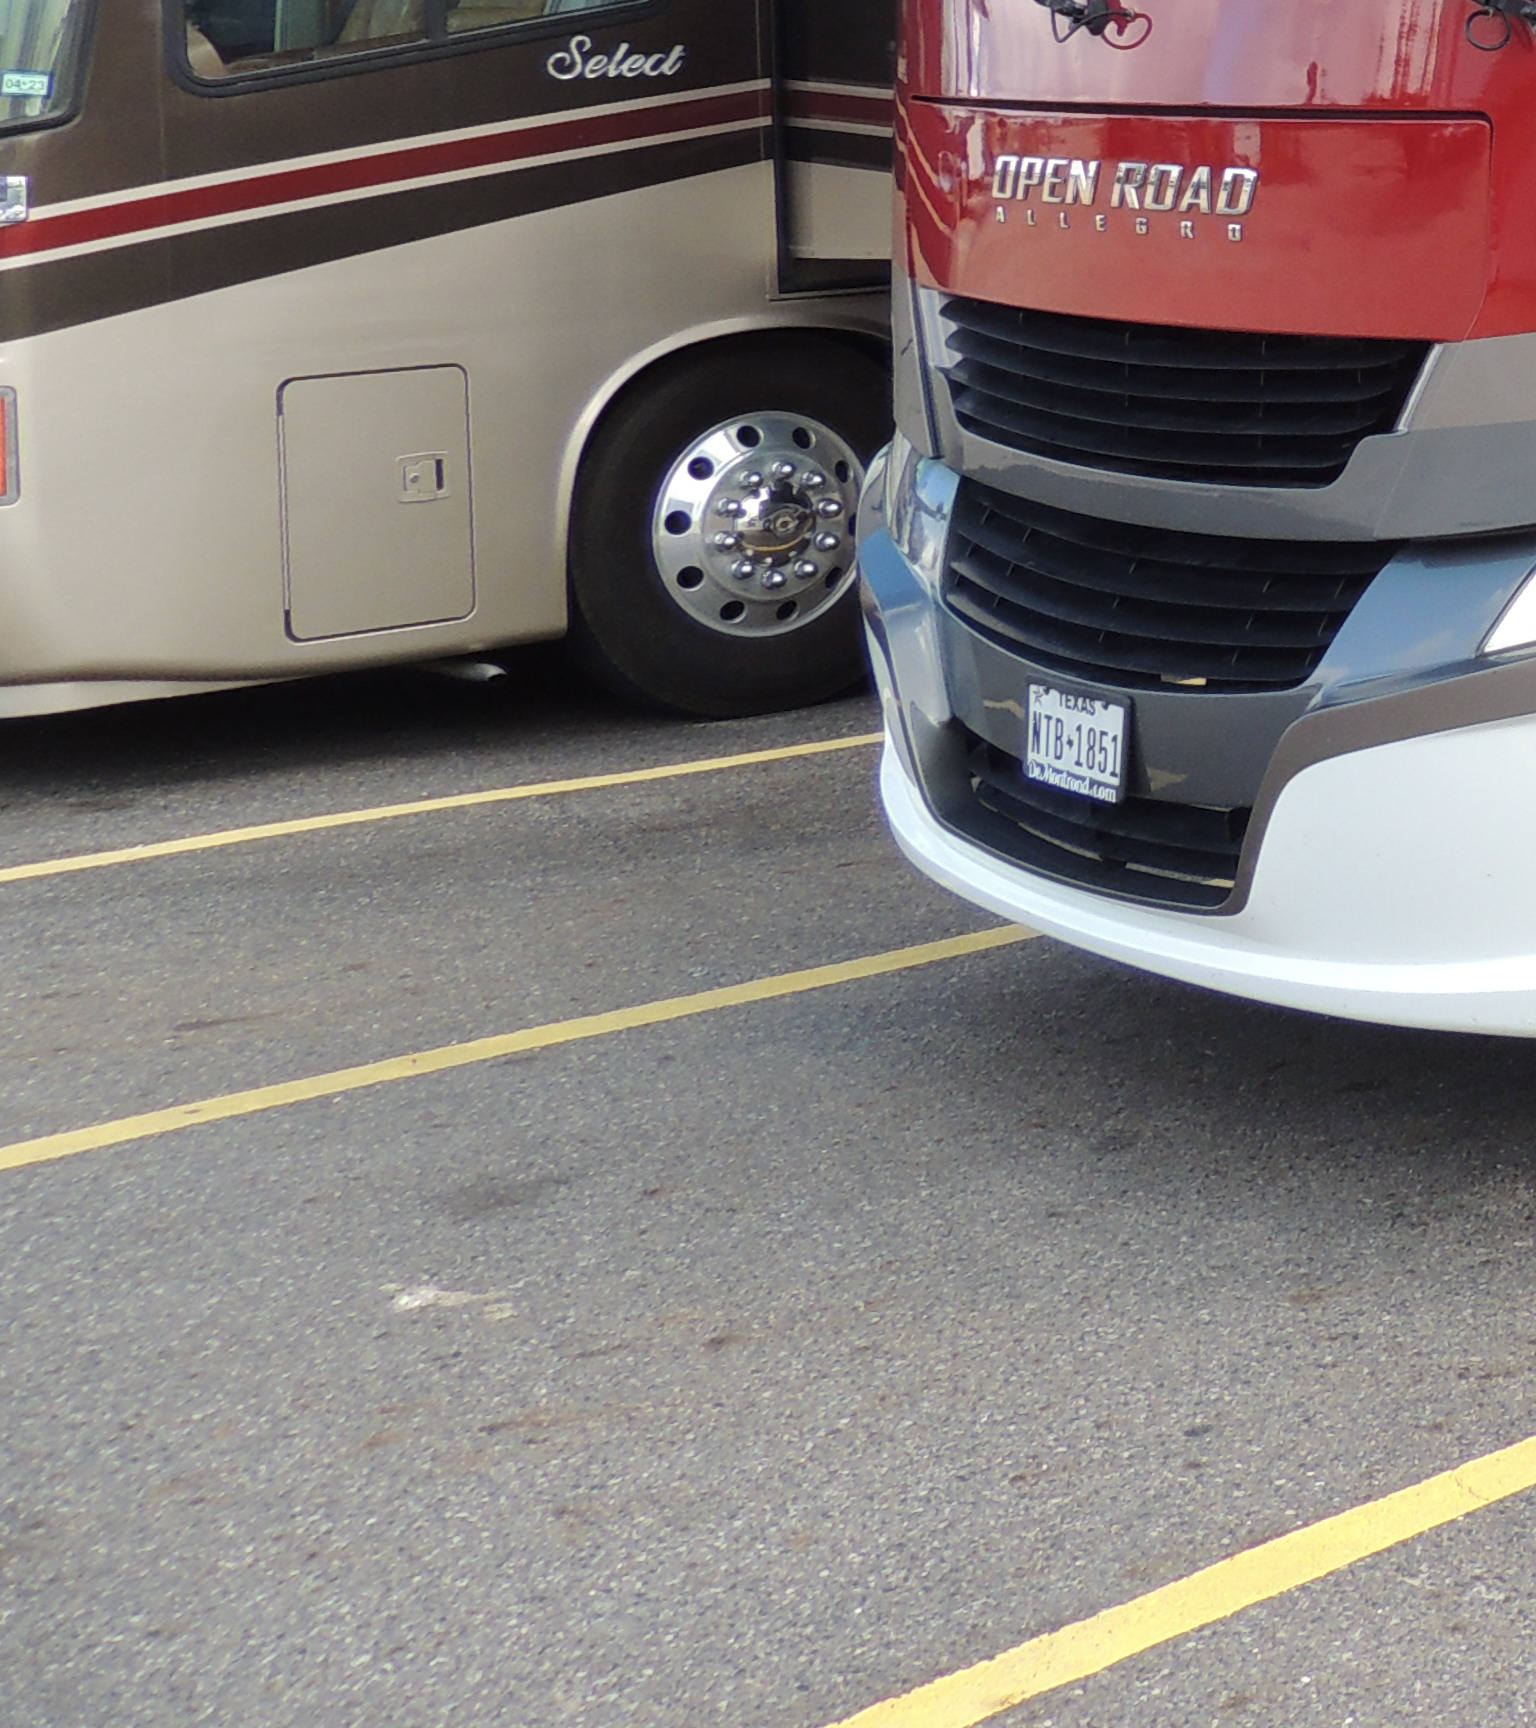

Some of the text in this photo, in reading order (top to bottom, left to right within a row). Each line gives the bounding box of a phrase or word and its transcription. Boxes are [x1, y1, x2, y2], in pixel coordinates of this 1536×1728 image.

[546, 35, 686, 80] Select
[991, 154, 1258, 215] OPEN ROAD
[995, 205, 1242, 242] ALLEGRO
[1059, 693, 1096, 716] TEXAS
